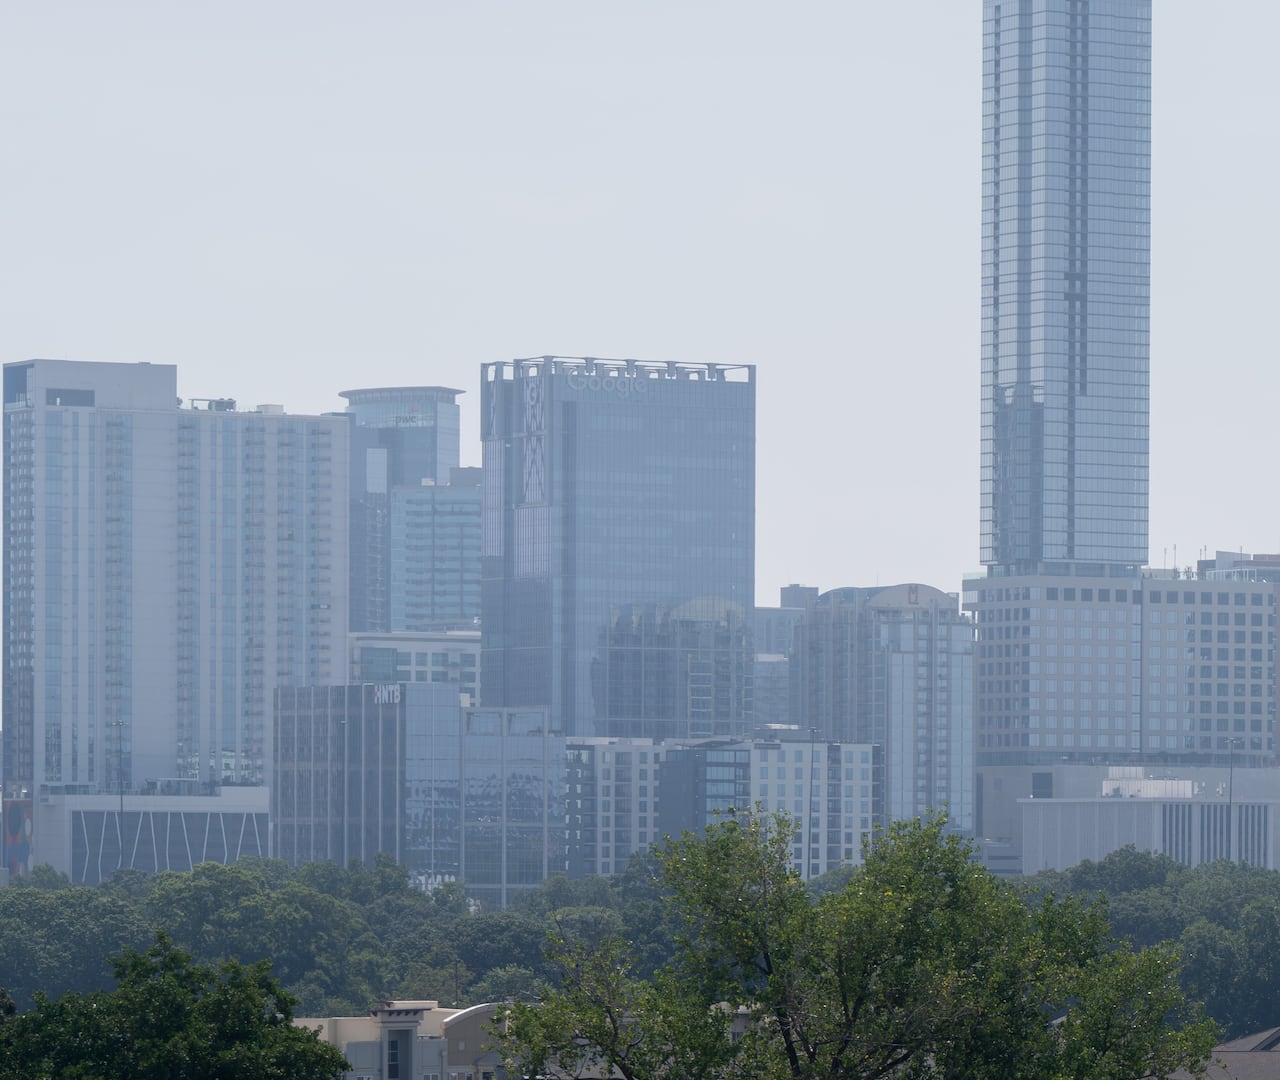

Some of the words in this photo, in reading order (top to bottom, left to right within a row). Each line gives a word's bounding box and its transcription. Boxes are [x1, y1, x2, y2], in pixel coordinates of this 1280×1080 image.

[567, 368, 647, 399] Google
[395, 415, 417, 425] pwc
[574, 683, 601, 705] HNTB
